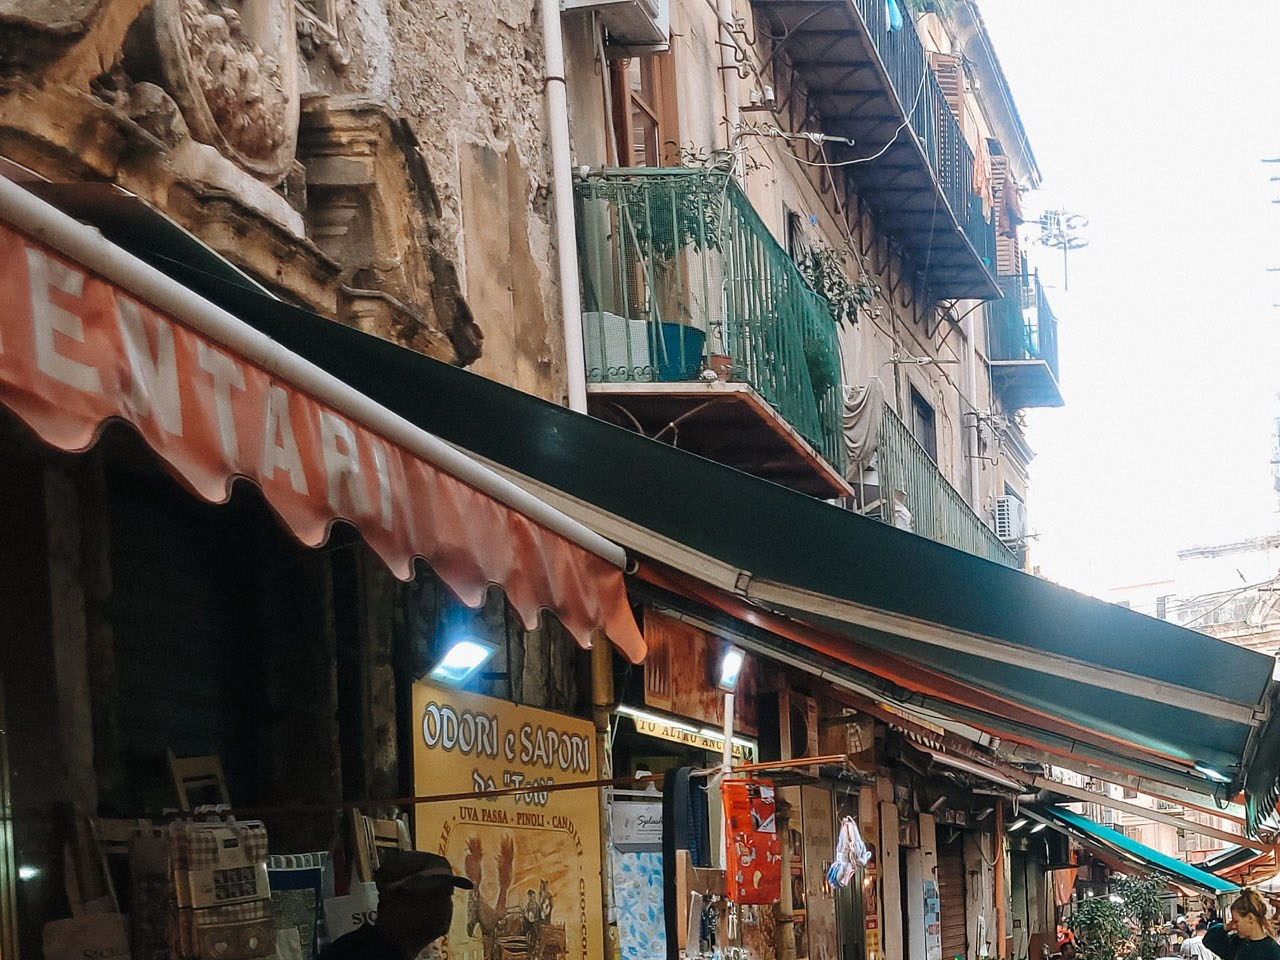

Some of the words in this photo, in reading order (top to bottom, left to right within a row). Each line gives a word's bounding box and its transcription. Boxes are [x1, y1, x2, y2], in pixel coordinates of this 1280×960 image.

[0, 246, 394, 532] ENTARI
[422, 702, 499, 760] ODORI
[504, 730, 516, 762] e
[520, 723, 591, 774] SAPORI
[702, 738, 741, 756] ANCRA
[459, 806, 480, 821] UVA
[481, 809, 509, 825] PASSA
[516, 811, 546, 828] PINOLI
